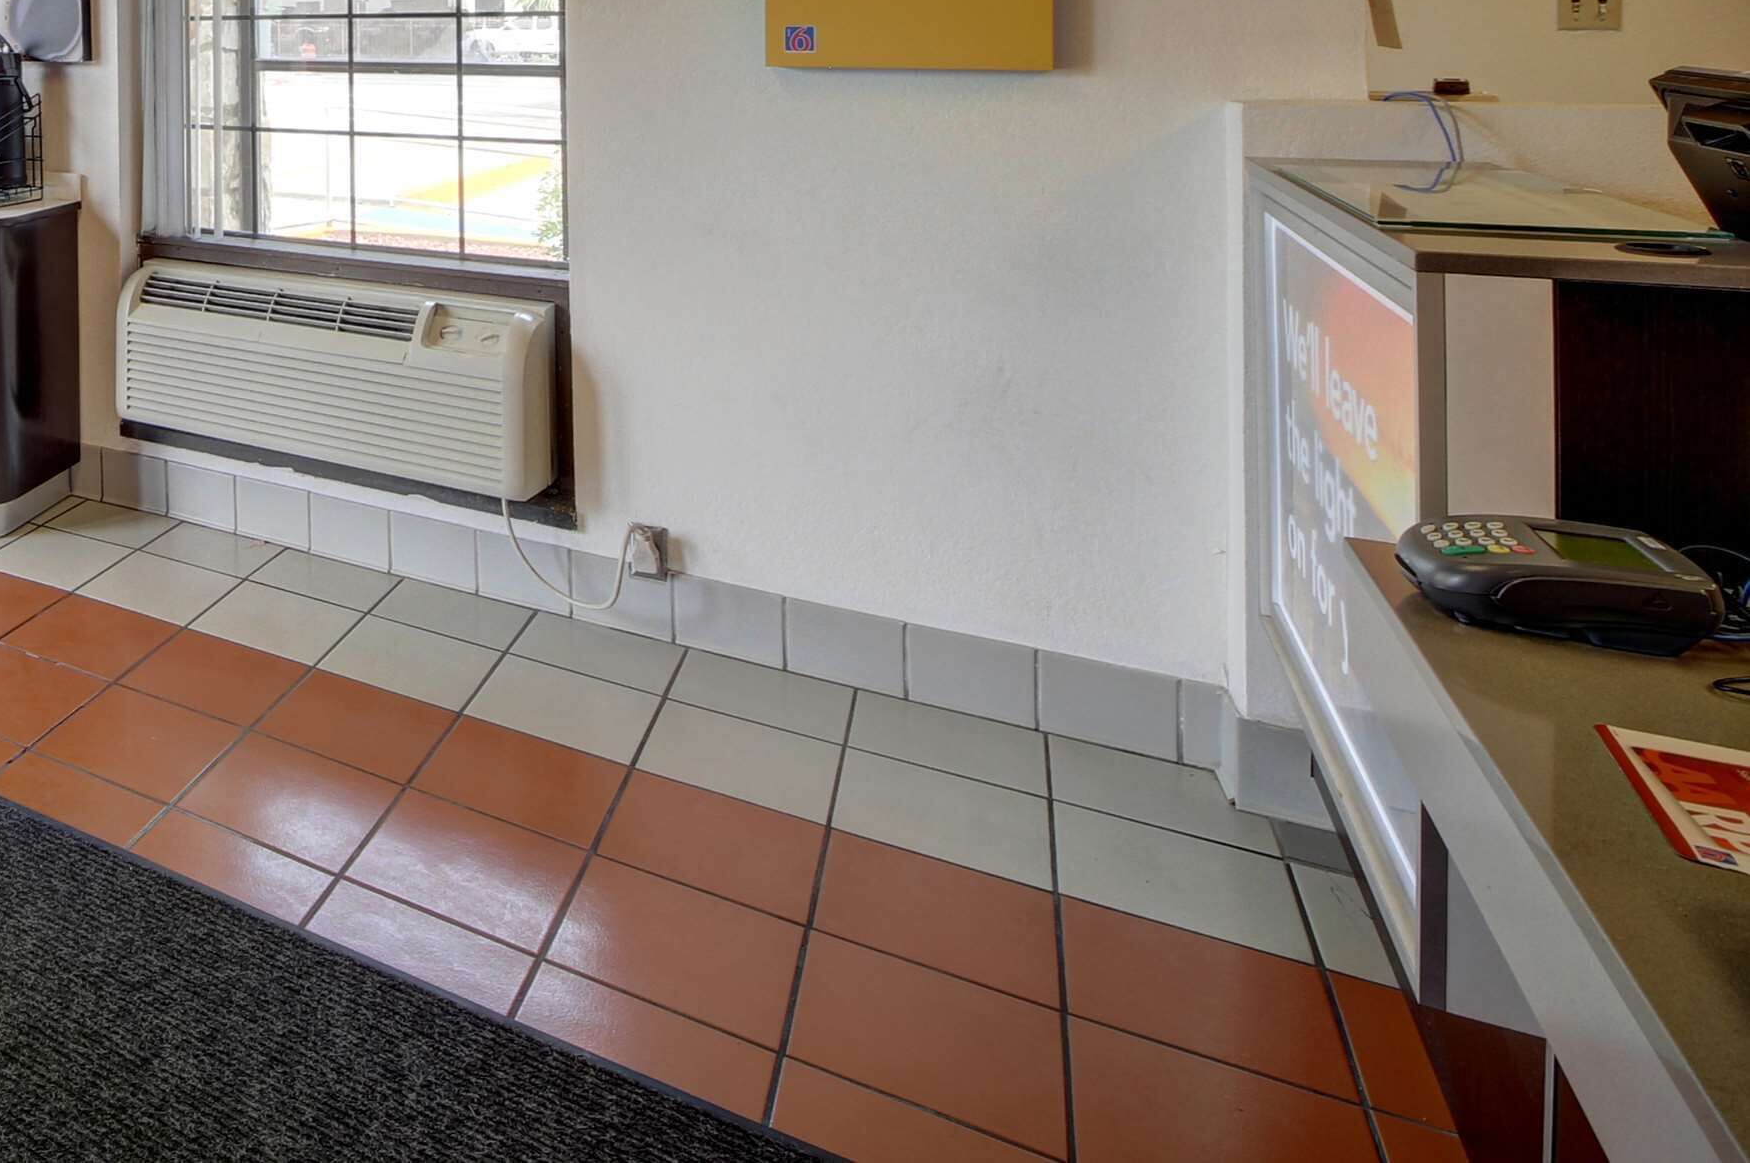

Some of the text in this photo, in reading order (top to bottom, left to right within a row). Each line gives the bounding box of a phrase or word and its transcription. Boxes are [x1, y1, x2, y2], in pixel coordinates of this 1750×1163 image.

[1283, 298, 1378, 460] We'll leave
[1286, 399, 1356, 542] the light
[1287, 514, 1336, 626] on for
